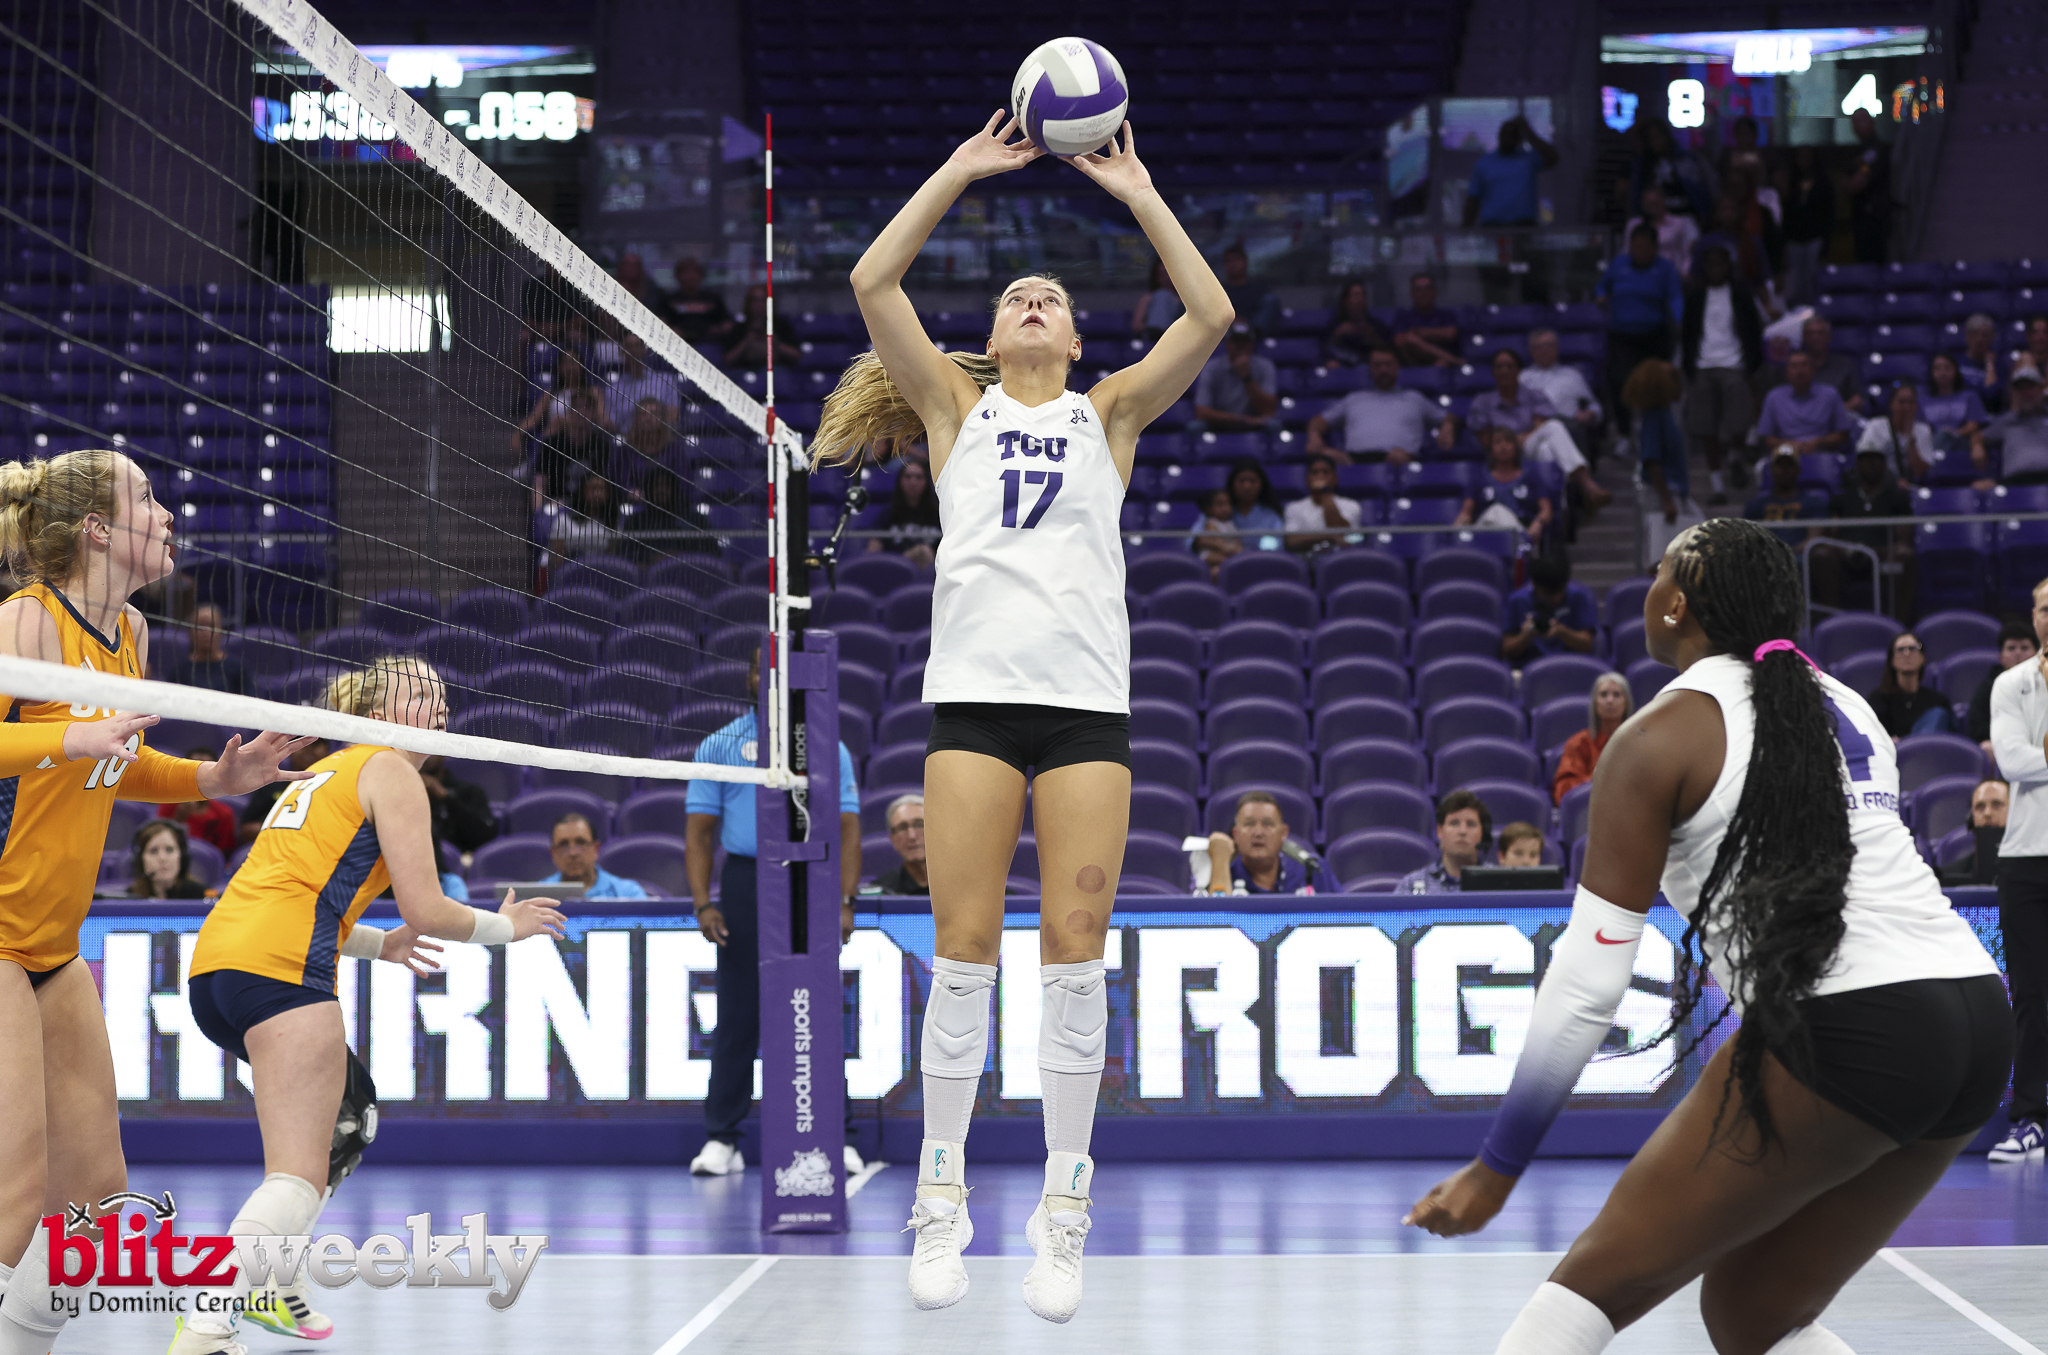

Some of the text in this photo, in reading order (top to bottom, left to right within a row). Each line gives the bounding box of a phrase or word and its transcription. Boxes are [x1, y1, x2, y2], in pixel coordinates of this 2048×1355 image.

[1668, 78, 1705, 128] 8
[1841, 73, 1883, 118] 4
[997, 430, 1068, 463] TCU
[999, 469, 1063, 529] 17
[83, 733, 140, 790] 10
[102, 929, 904, 1102] HRNED
[790, 987, 815, 1134] sports imports
